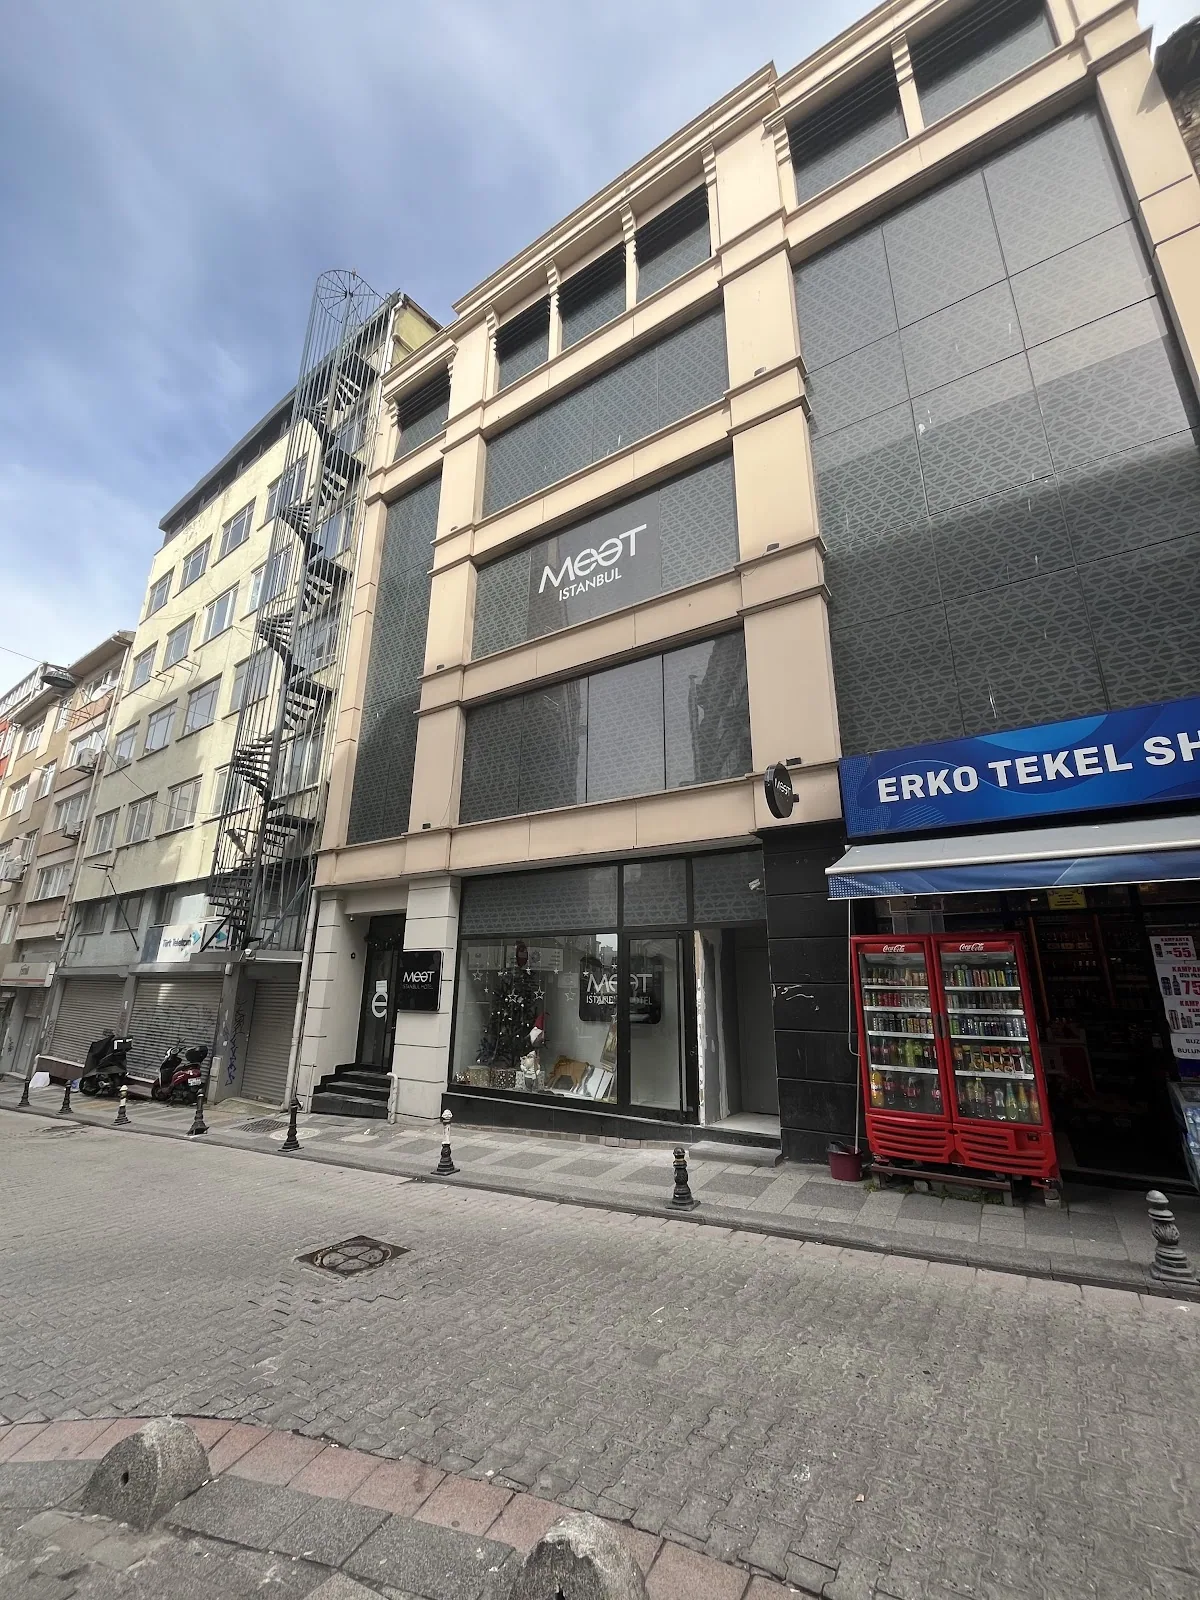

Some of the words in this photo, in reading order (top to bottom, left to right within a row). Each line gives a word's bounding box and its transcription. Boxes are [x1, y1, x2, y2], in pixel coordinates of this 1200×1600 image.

[559, 567, 622, 602] ISTANBUL
[877, 765, 980, 804] ERKO
[987, 743, 1133, 788] TEKEL
[1173, 947, 1191, 957] 55
